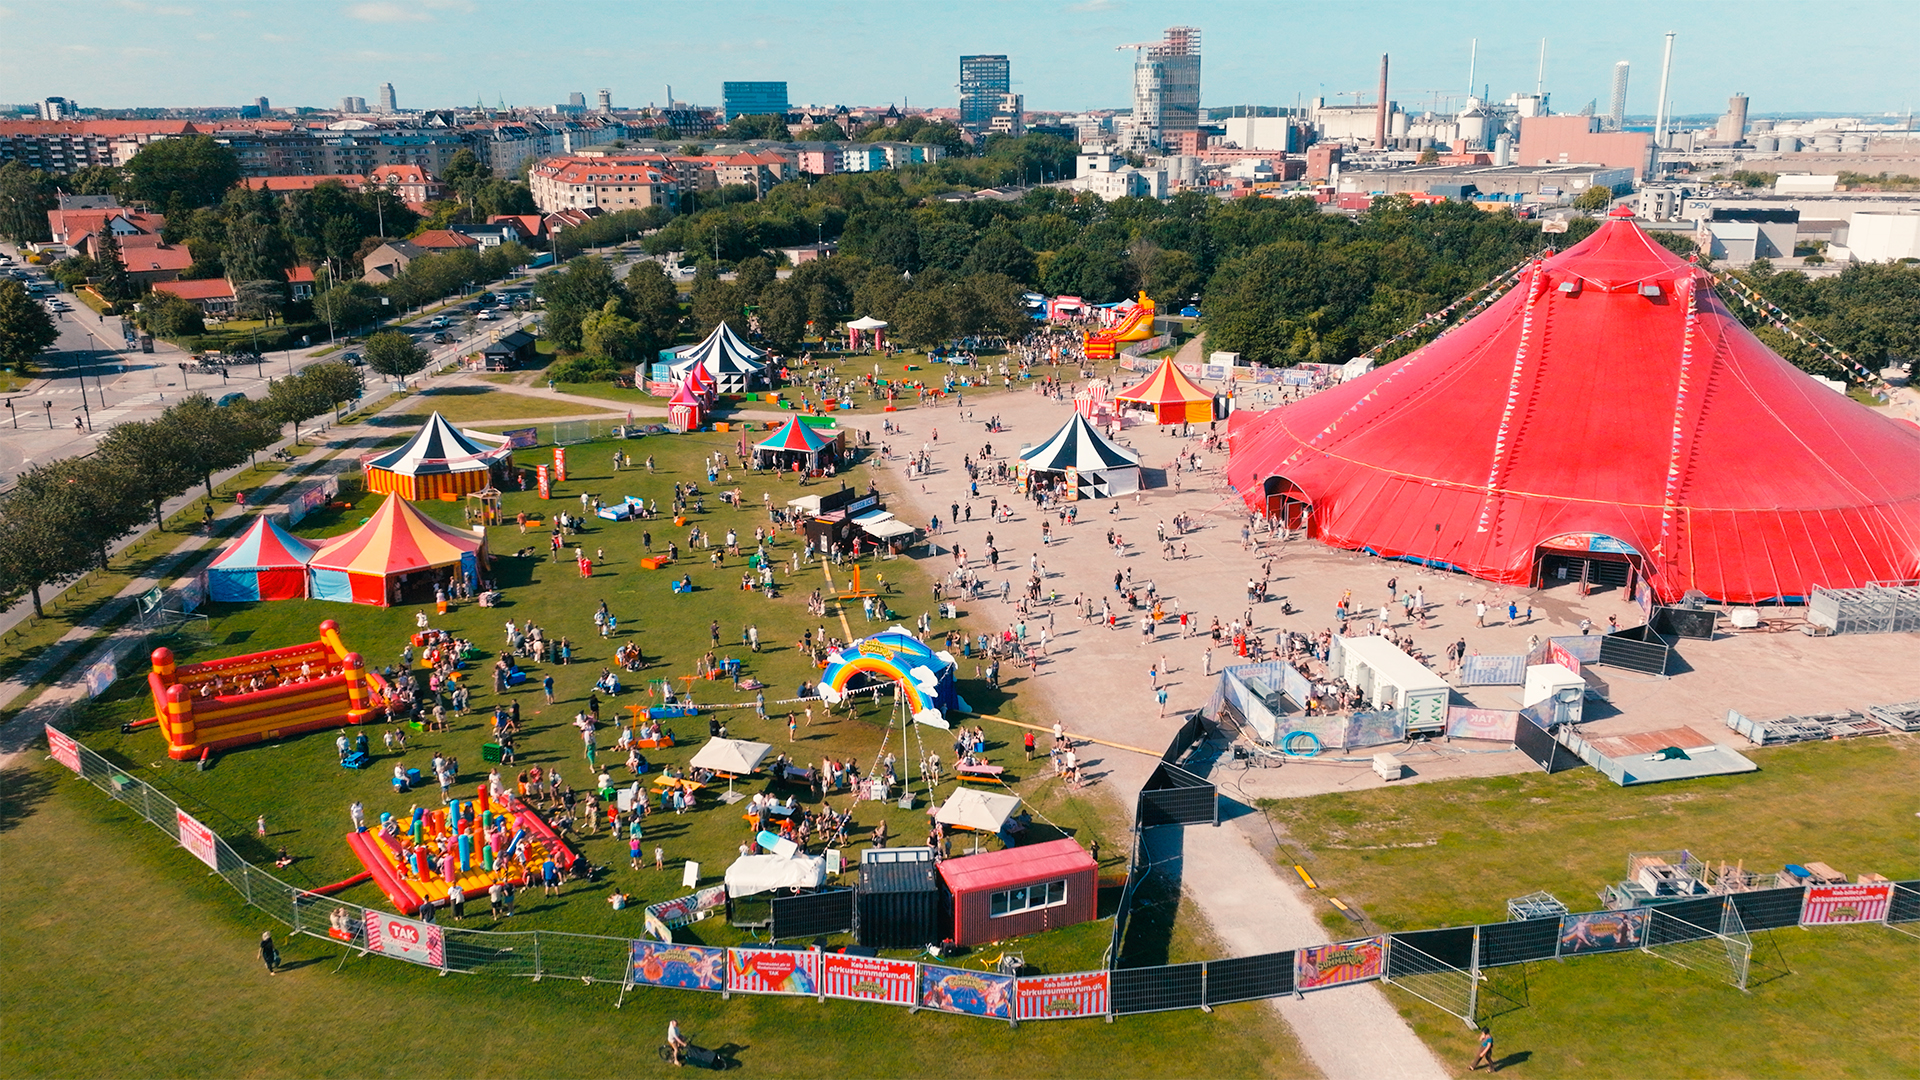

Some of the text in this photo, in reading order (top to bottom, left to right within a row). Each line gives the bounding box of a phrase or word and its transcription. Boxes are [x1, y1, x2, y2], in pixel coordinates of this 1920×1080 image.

[1689, 201, 1712, 209] DSV
[1556, 650, 1568, 666] TAK
[391, 925, 417, 942] TAK
[1326, 949, 1356, 960] CIRKUS
[828, 965, 911, 980] cirkussummarum.dk
[863, 963, 880, 971] billet
[1021, 983, 1103, 996] cirkussummarum.dk
